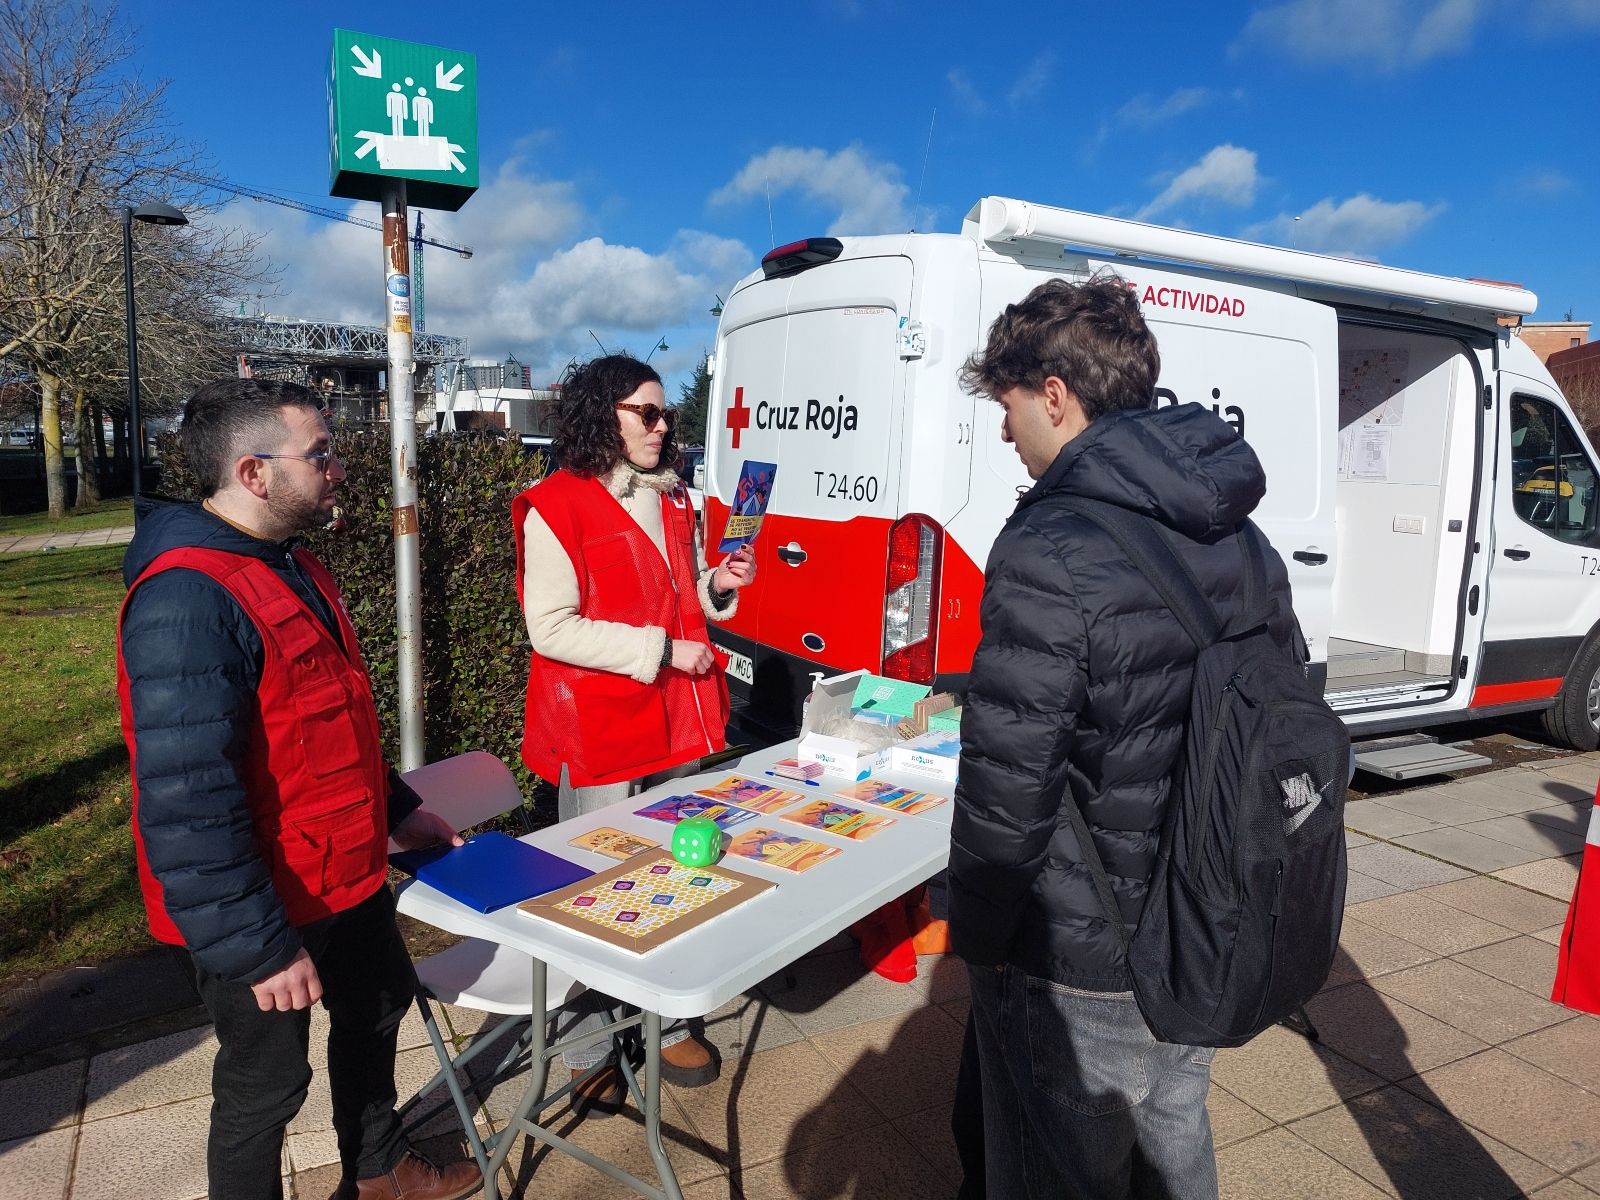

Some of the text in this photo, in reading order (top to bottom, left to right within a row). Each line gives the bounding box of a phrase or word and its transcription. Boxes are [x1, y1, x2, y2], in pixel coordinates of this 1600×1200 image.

[1142, 285, 1245, 318] ACTIVIDAD
[756, 394, 859, 440] Cruz Roja
[814, 471, 878, 503] T 24.60
[1580, 556, 1589, 576] T
